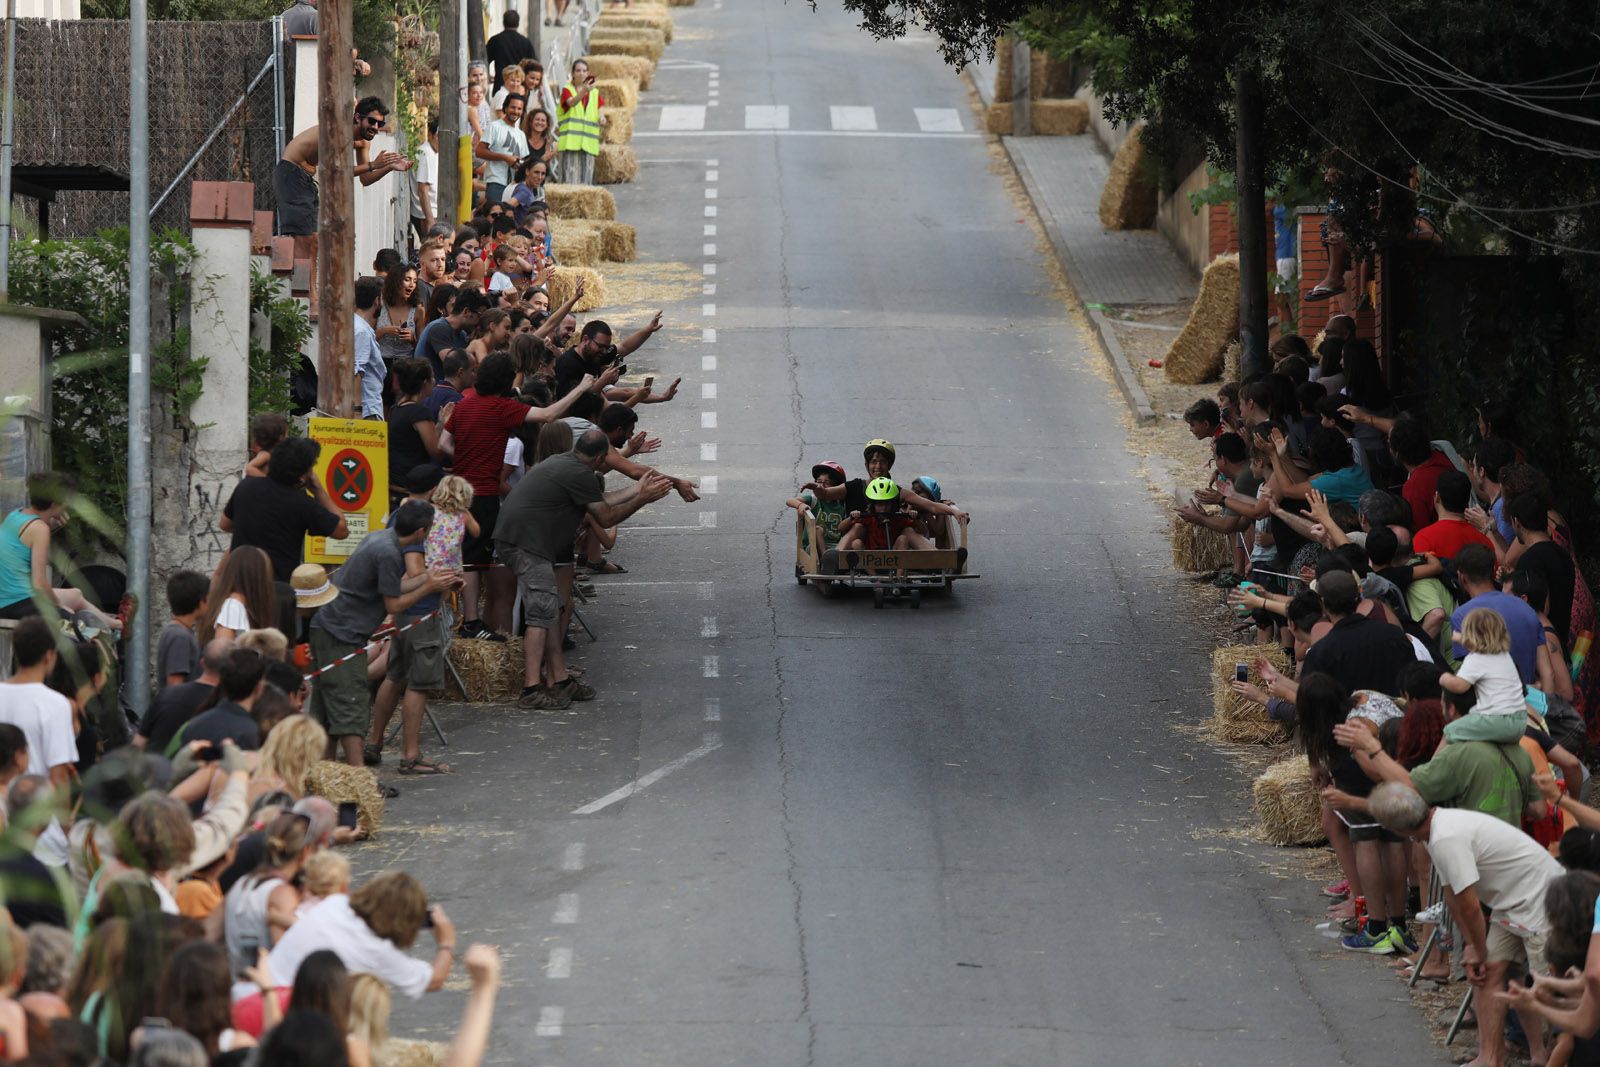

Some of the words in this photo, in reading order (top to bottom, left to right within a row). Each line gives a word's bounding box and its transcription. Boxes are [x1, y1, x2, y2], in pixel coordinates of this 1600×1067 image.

[313, 424, 345, 433] Ajuntament
[353, 439, 386, 449] excepcional
[862, 554, 899, 566] iPalet
